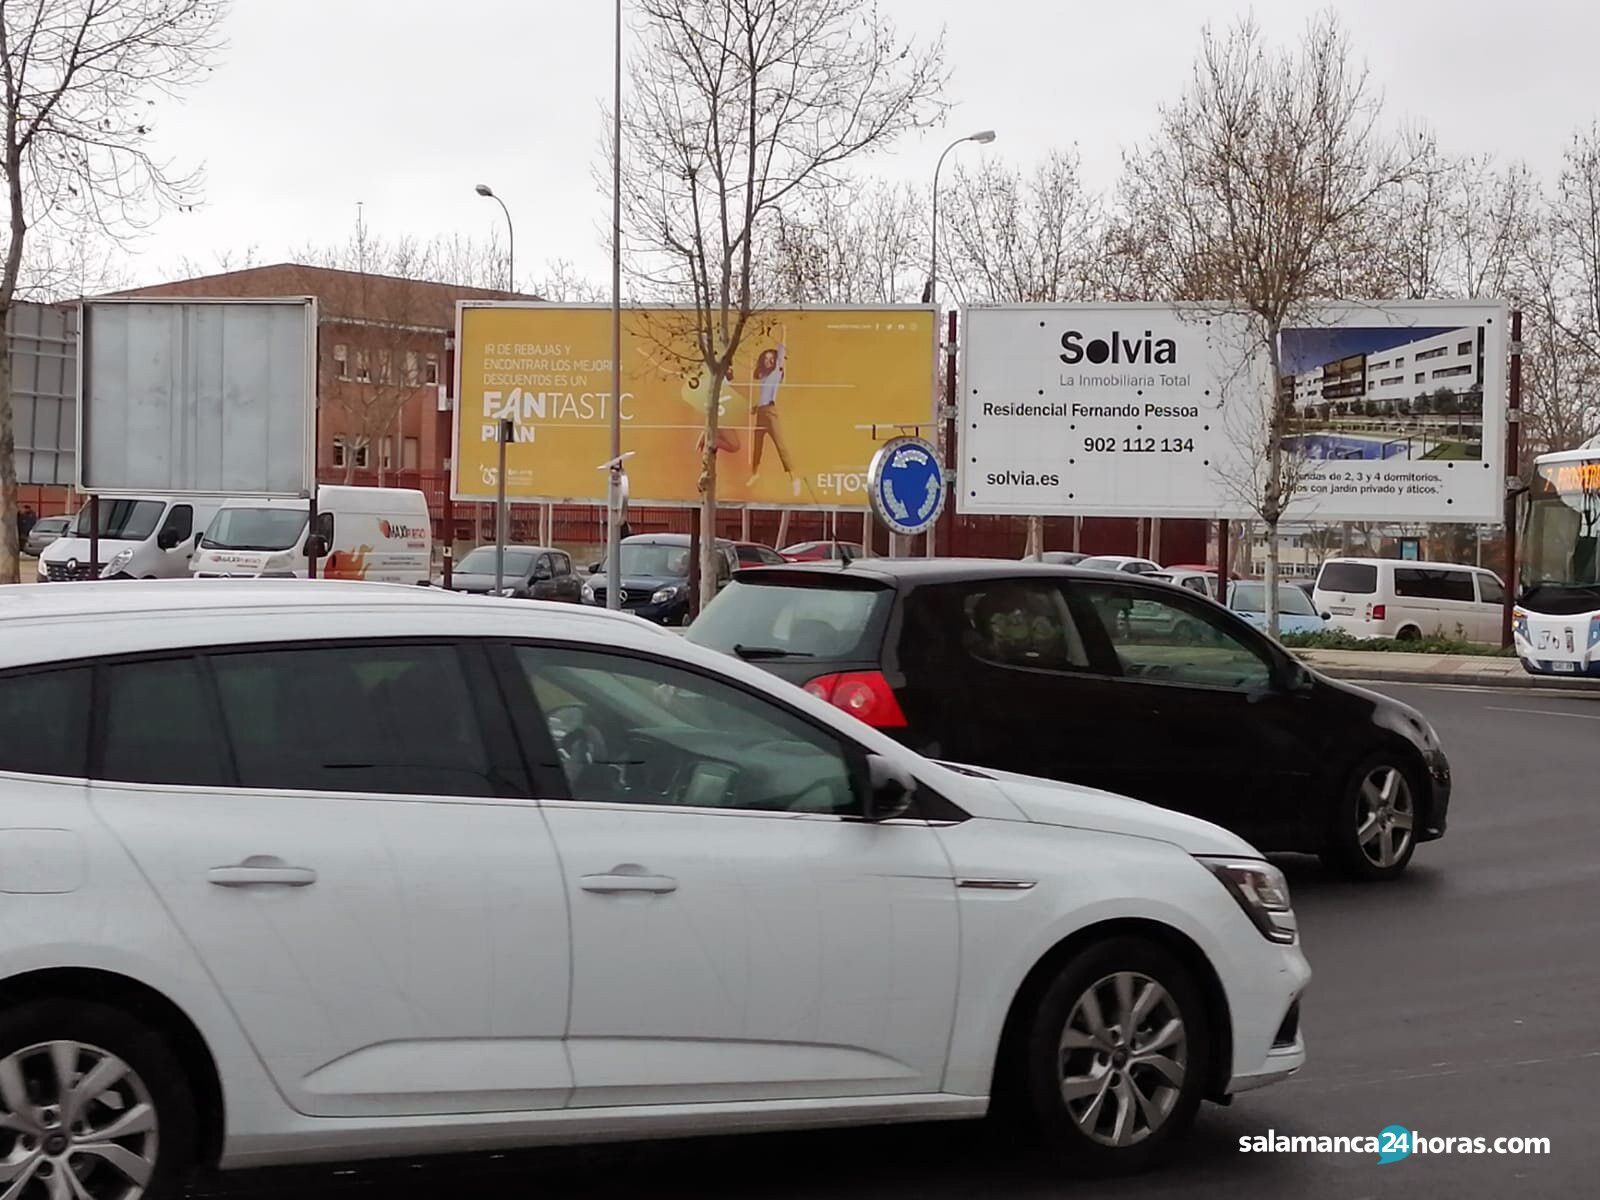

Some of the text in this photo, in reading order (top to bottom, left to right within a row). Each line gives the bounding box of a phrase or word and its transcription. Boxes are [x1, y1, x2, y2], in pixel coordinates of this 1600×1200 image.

[485, 344, 571, 355] IR DE REBAJAS Y
[1059, 330, 1177, 365] Solvia
[484, 359, 623, 372] ENCONTRAR LOS MEJOR
[483, 375, 587, 387] DESCUENTOS ES UN
[1059, 374, 1191, 387] La Inmobiliaria Total
[483, 387, 635, 425] FANTASTC
[983, 403, 1199, 418] Residencial Fernando Pessoa
[1083, 437, 1195, 453] 902 112 134
[986, 470, 1060, 487] solvia.es
[1329, 472, 1342, 481] de
[1344, 472, 1354, 482] 2,
[1356, 472, 1364, 481] 3
[1365, 473, 1371, 483] y
[1373, 472, 1380, 481] 4
[1383, 472, 1442, 482] dormitorios.
[1310, 485, 1328, 493] con
[1360, 484, 1396, 495] privado
[1397, 486, 1404, 496] y
